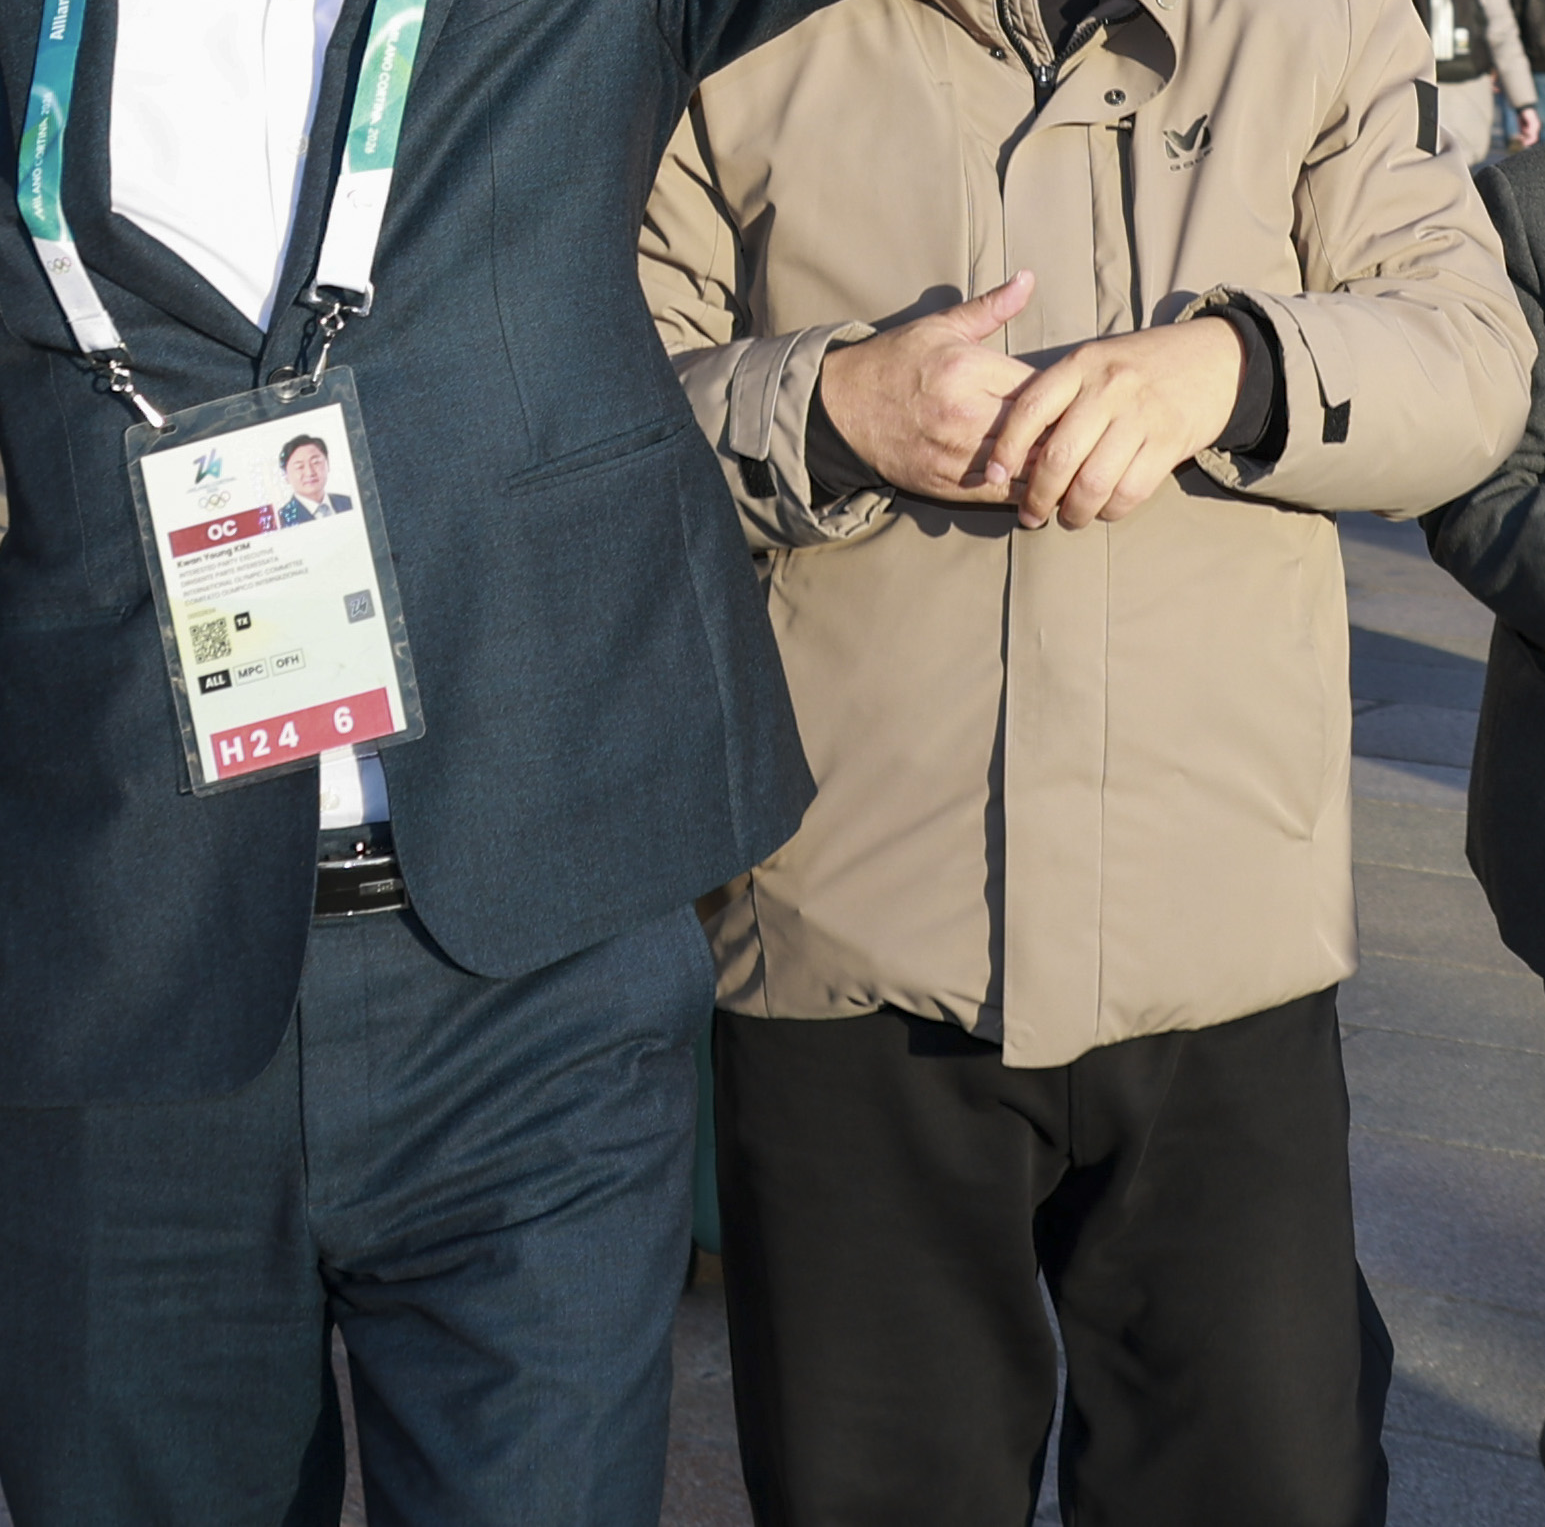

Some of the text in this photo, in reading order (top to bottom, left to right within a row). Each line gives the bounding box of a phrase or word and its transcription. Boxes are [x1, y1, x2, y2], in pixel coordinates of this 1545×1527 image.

[31, 166, 46, 220] MILANO
[207, 519, 238, 541] OC
[176, 542, 250, 568] Kwan Young KIM
[204, 655, 299, 689] ALL MPC OFH
[333, 706, 354, 734] 6
